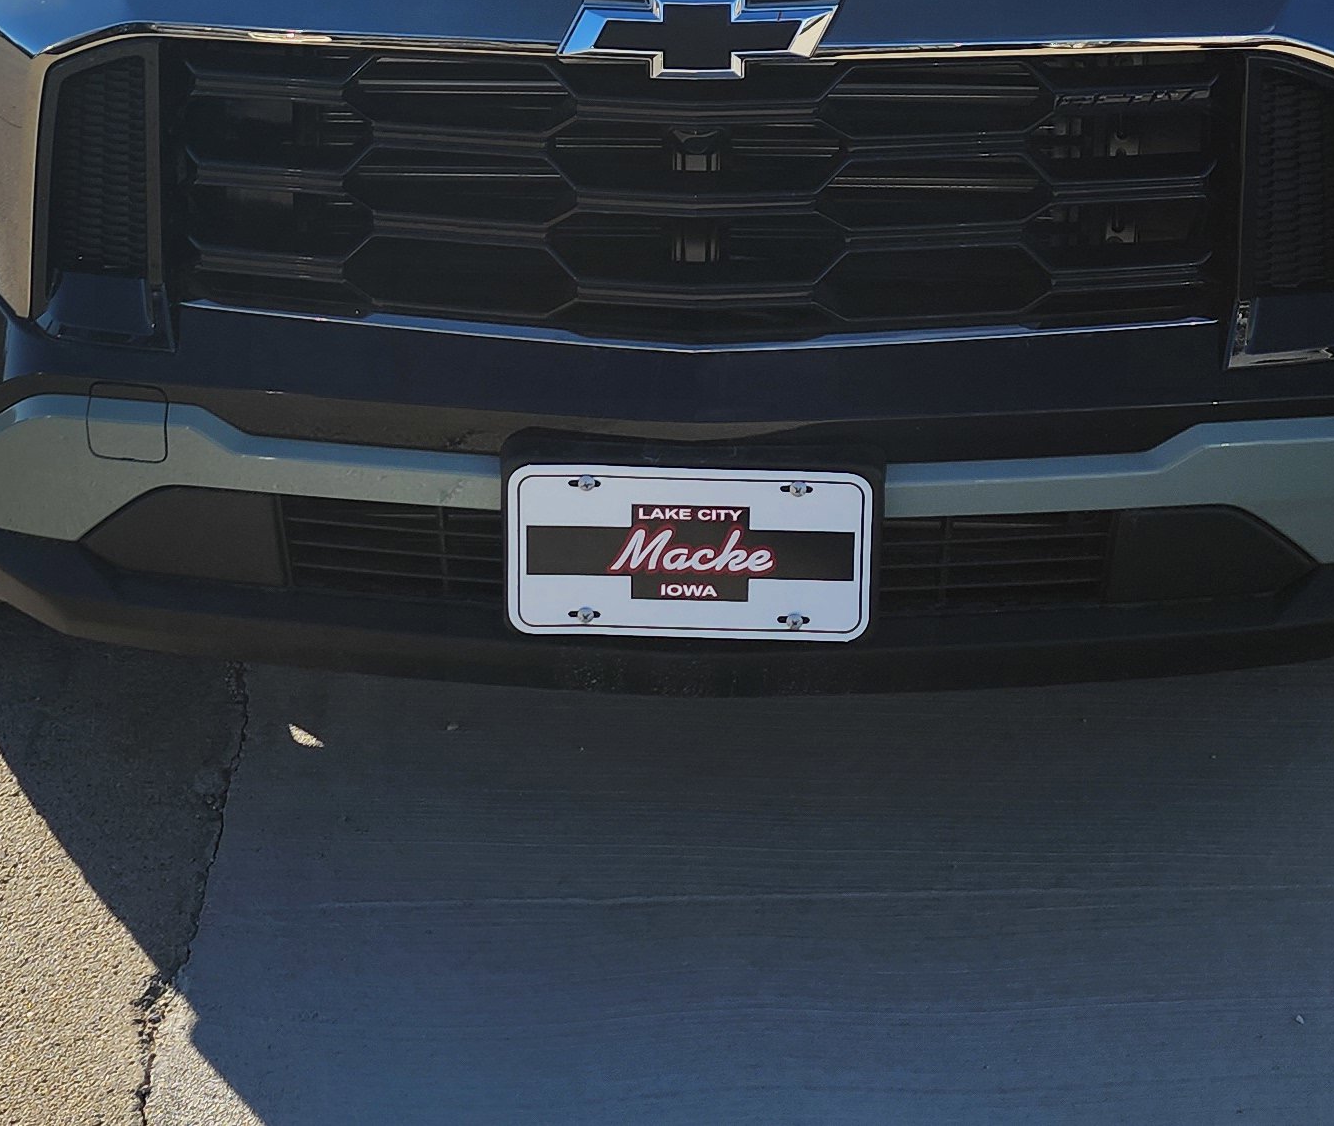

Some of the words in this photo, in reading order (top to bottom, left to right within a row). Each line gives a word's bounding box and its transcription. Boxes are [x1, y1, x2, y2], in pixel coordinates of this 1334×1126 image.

[638, 507, 692, 520] LAKE
[697, 509, 743, 522] CITY
[609, 528, 775, 572] Macke
[660, 583, 718, 598] IOWA
